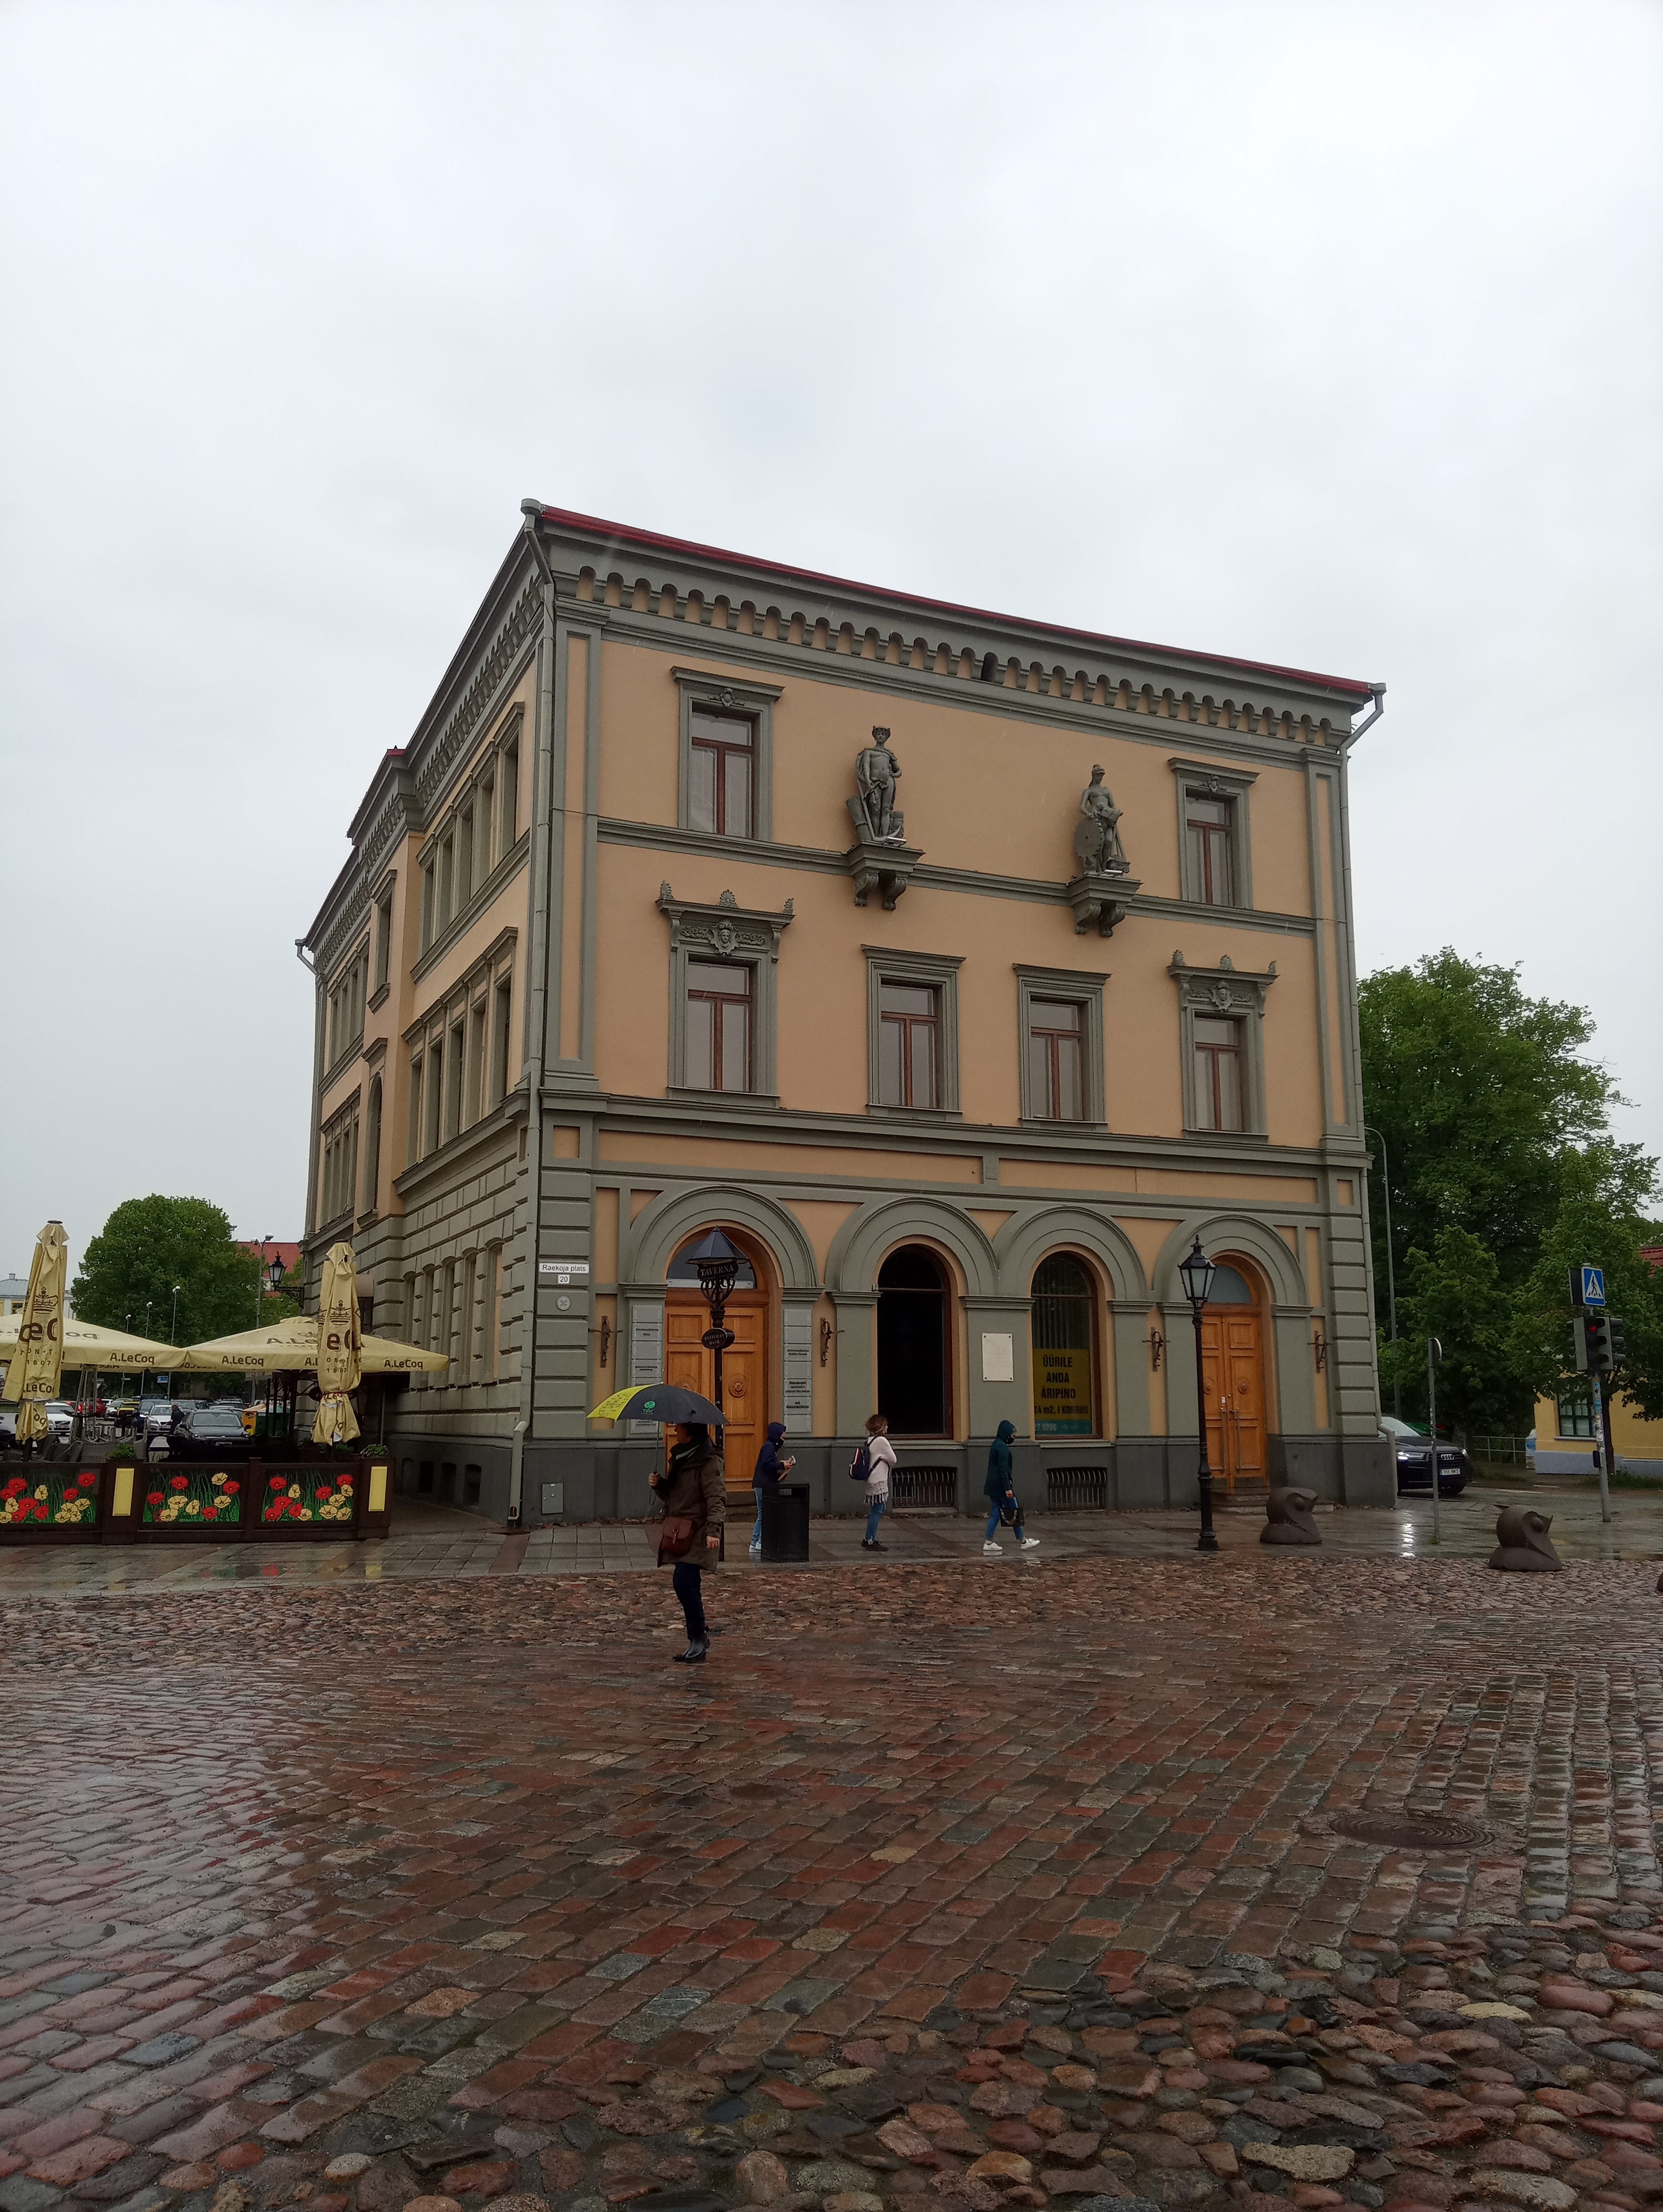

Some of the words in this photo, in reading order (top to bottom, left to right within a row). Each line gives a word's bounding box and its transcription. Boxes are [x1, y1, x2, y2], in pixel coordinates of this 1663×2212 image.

[542, 1264, 569, 1272] Raekoja
[700, 1264, 734, 1277] TAVERNA
[1043, 1354, 1073, 1368] ÜÜRILE
[1047, 1372, 1070, 1383] ANDA
[1041, 1386, 1076, 1399] ÄRIPIND
[1062, 1406, 1088, 1414] KORRUS
